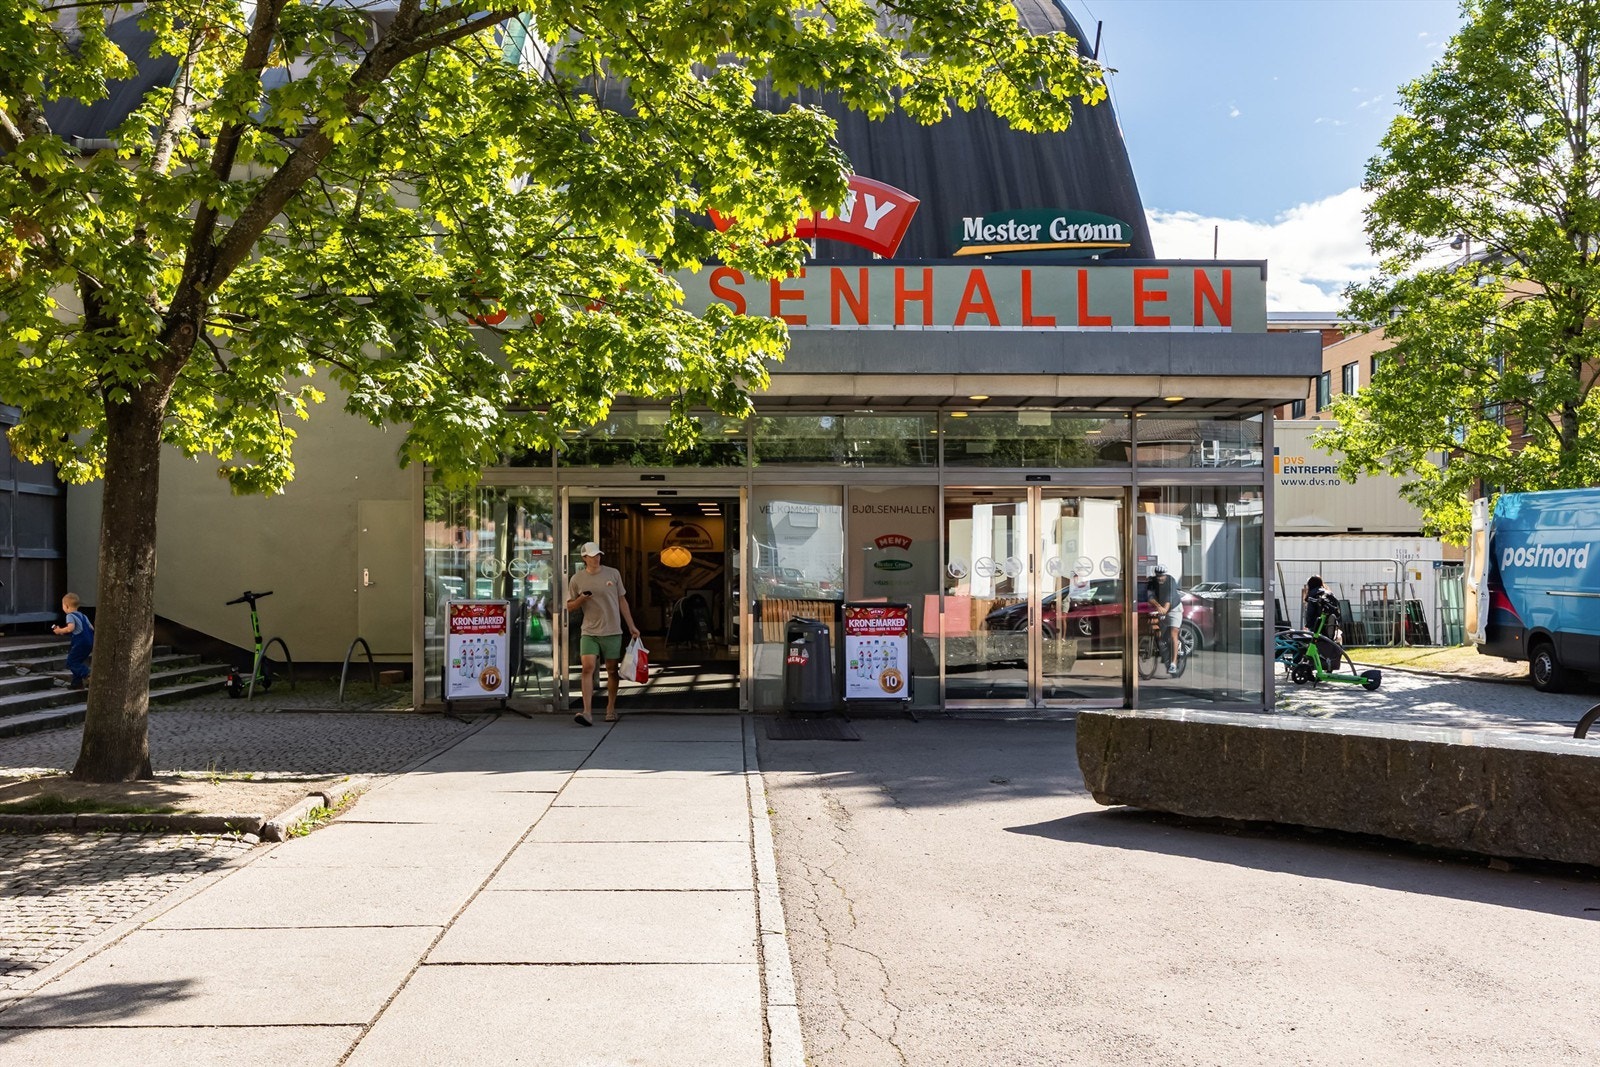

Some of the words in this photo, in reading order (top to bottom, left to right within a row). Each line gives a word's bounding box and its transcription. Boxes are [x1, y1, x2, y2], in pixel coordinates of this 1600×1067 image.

[962, 217, 1042, 241] Mester
[1049, 216, 1123, 242] Grønn
[1283, 456, 1305, 465] DVS
[1280, 477, 1341, 486] www.dvs.no
[759, 505, 820, 515] VELKOMMEN
[852, 504, 936, 515] BJØLSENHALLEN
[879, 537, 908, 546] MENY
[1501, 543, 1591, 571] postnord
[452, 616, 504, 626] KRONEMARKED
[848, 618, 906, 628] KRONEMARKED
[485, 673, 496, 685] 10
[885, 675, 898, 687] 10
